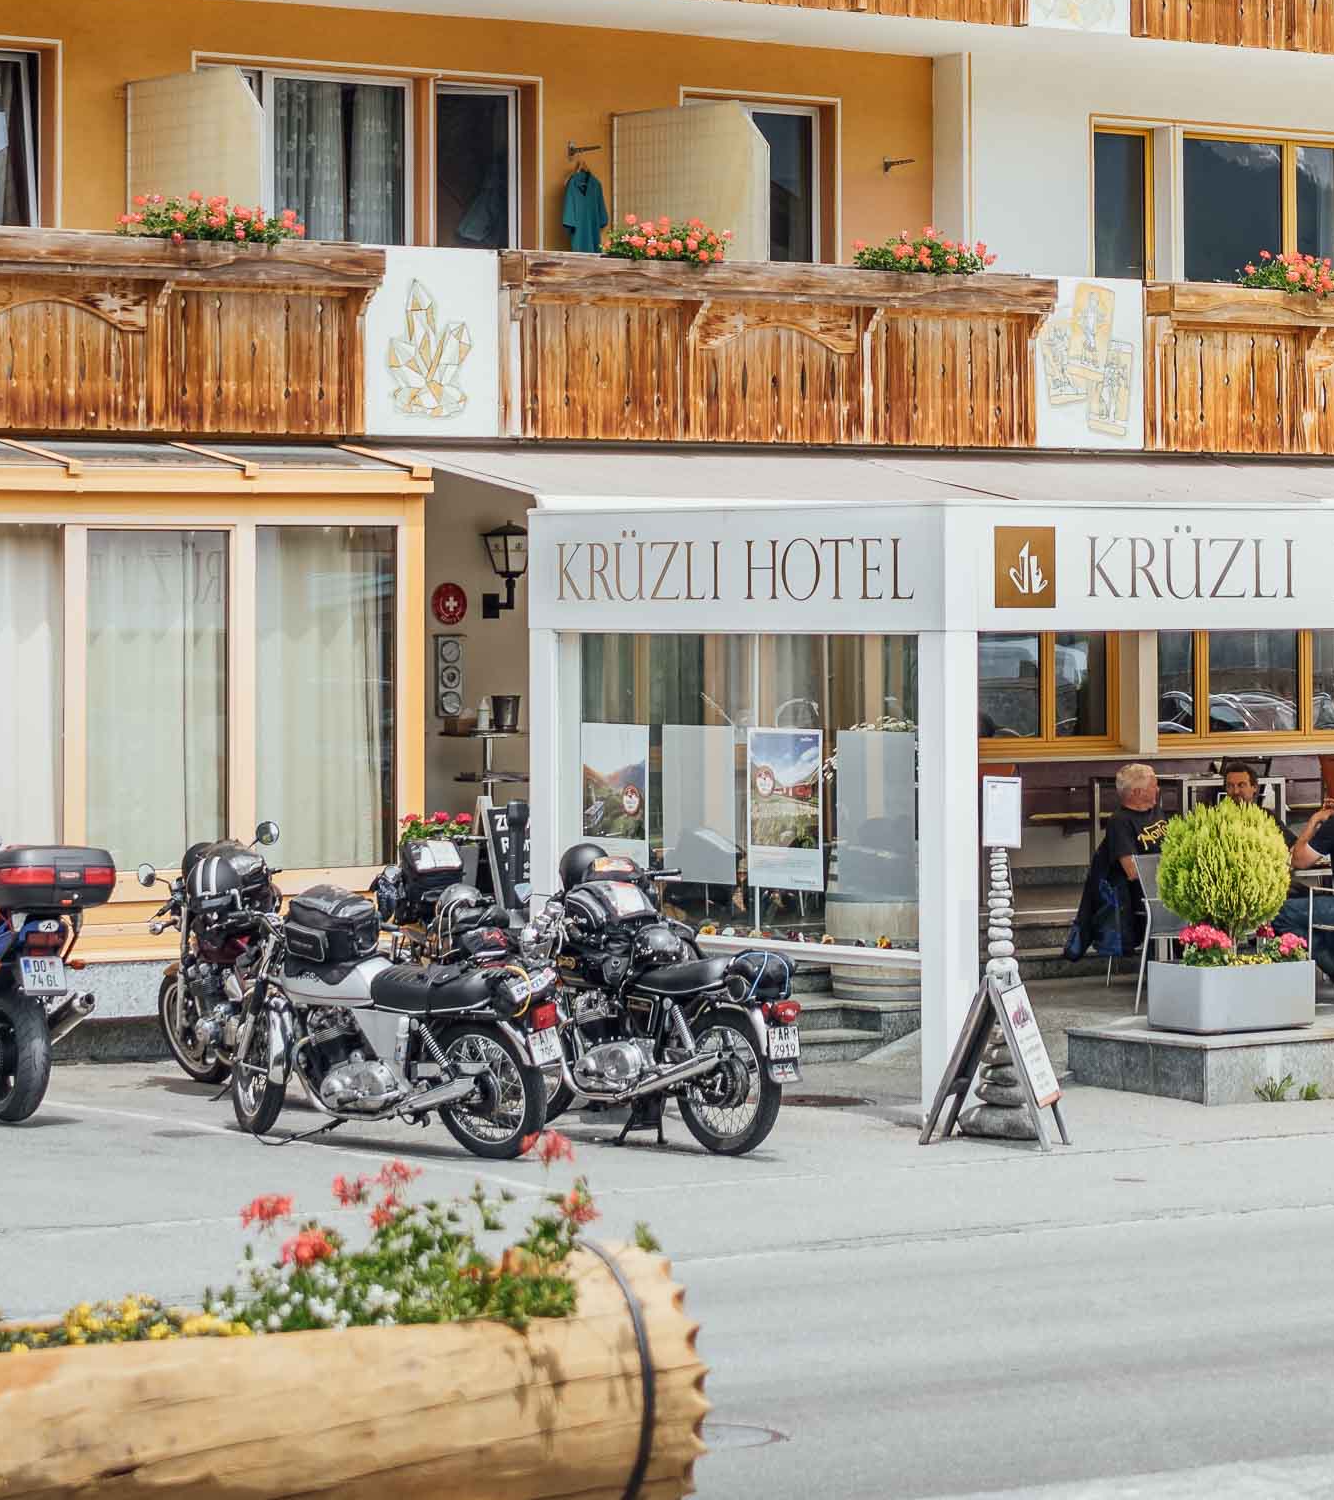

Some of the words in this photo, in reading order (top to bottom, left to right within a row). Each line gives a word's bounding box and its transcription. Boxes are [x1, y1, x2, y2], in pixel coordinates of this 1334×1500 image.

[555, 530, 723, 601] KRÜZLI
[743, 536, 915, 601] HOTEL
[1086, 525, 1297, 600] KRÜZLI
